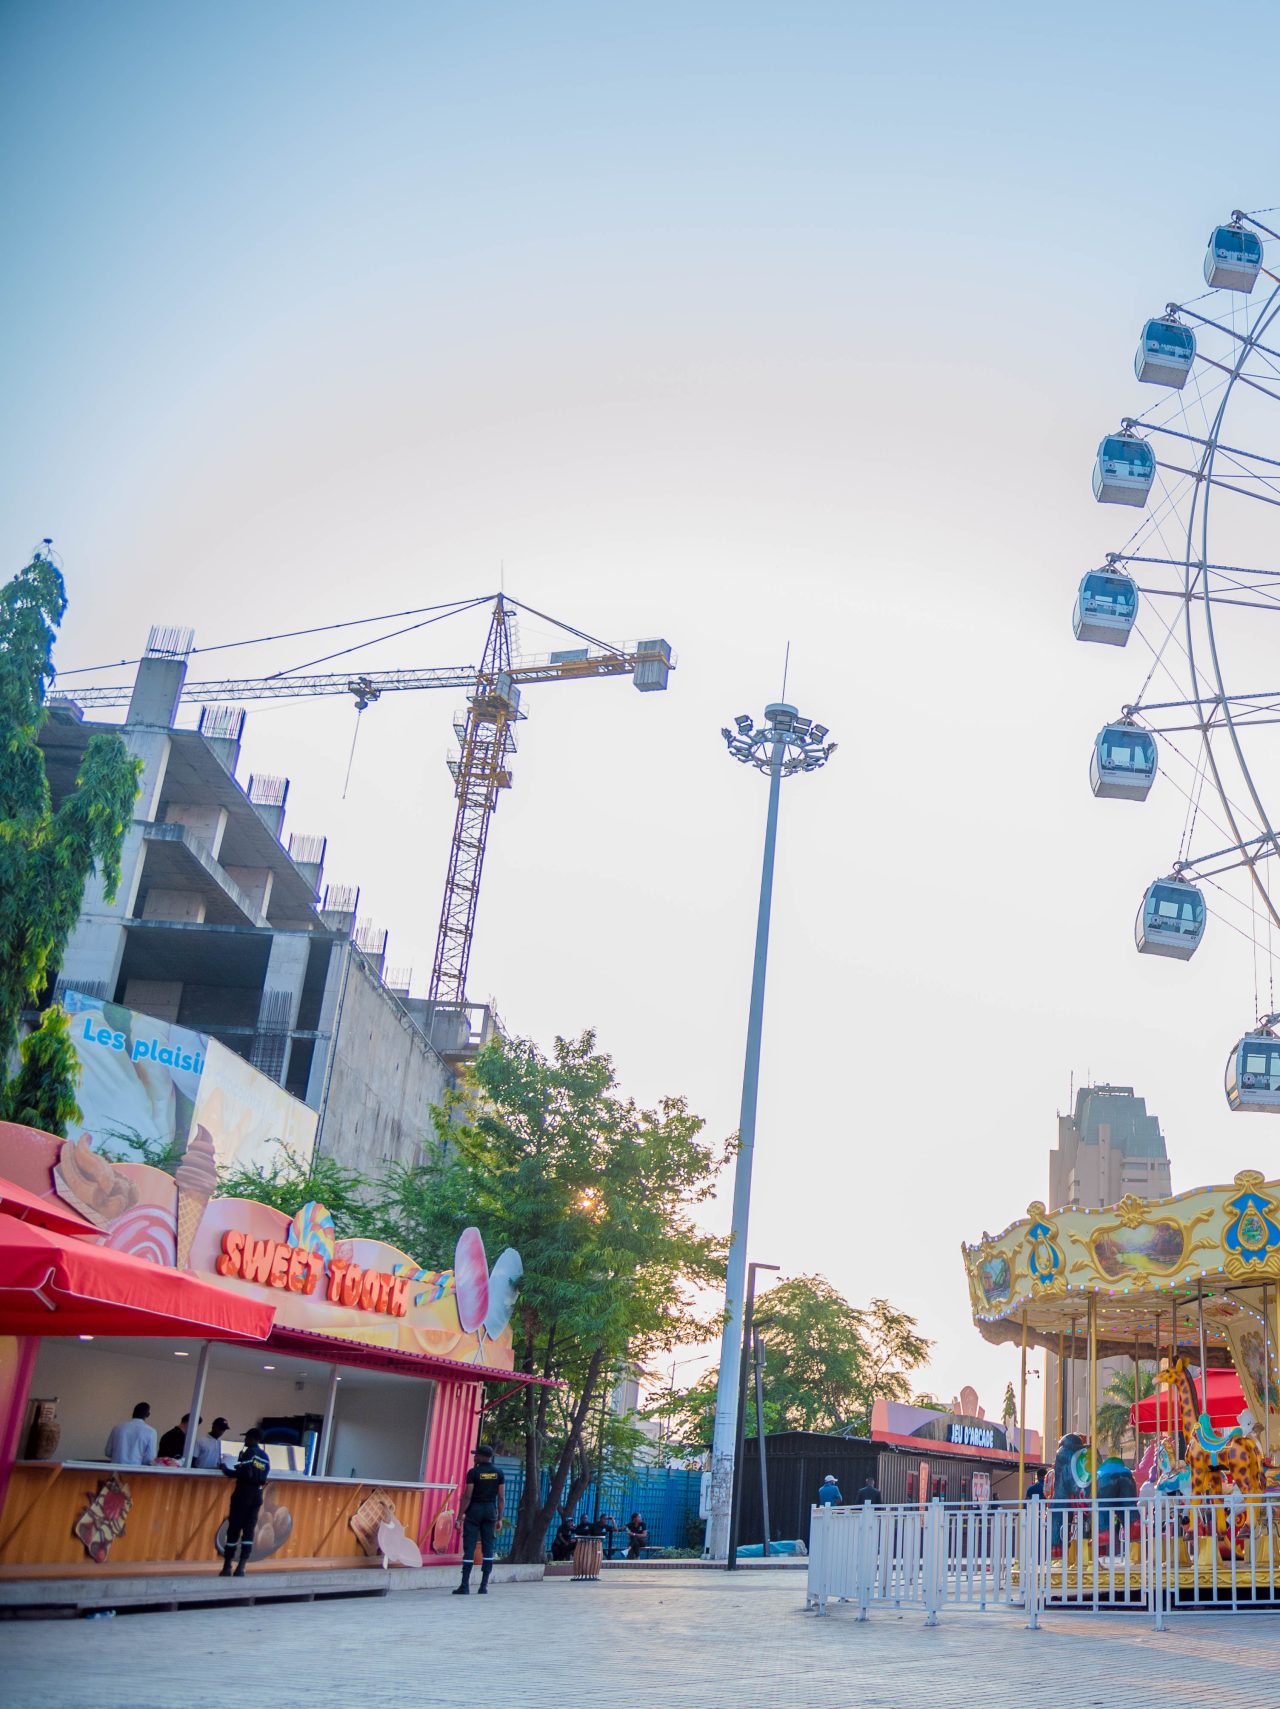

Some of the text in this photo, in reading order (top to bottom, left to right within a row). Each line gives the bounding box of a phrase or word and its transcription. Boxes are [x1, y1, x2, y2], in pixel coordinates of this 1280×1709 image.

[83, 1017, 127, 1051] Les
[215, 1228, 409, 1318] SWEET TOOTH
[951, 1423, 963, 1444] JEU
